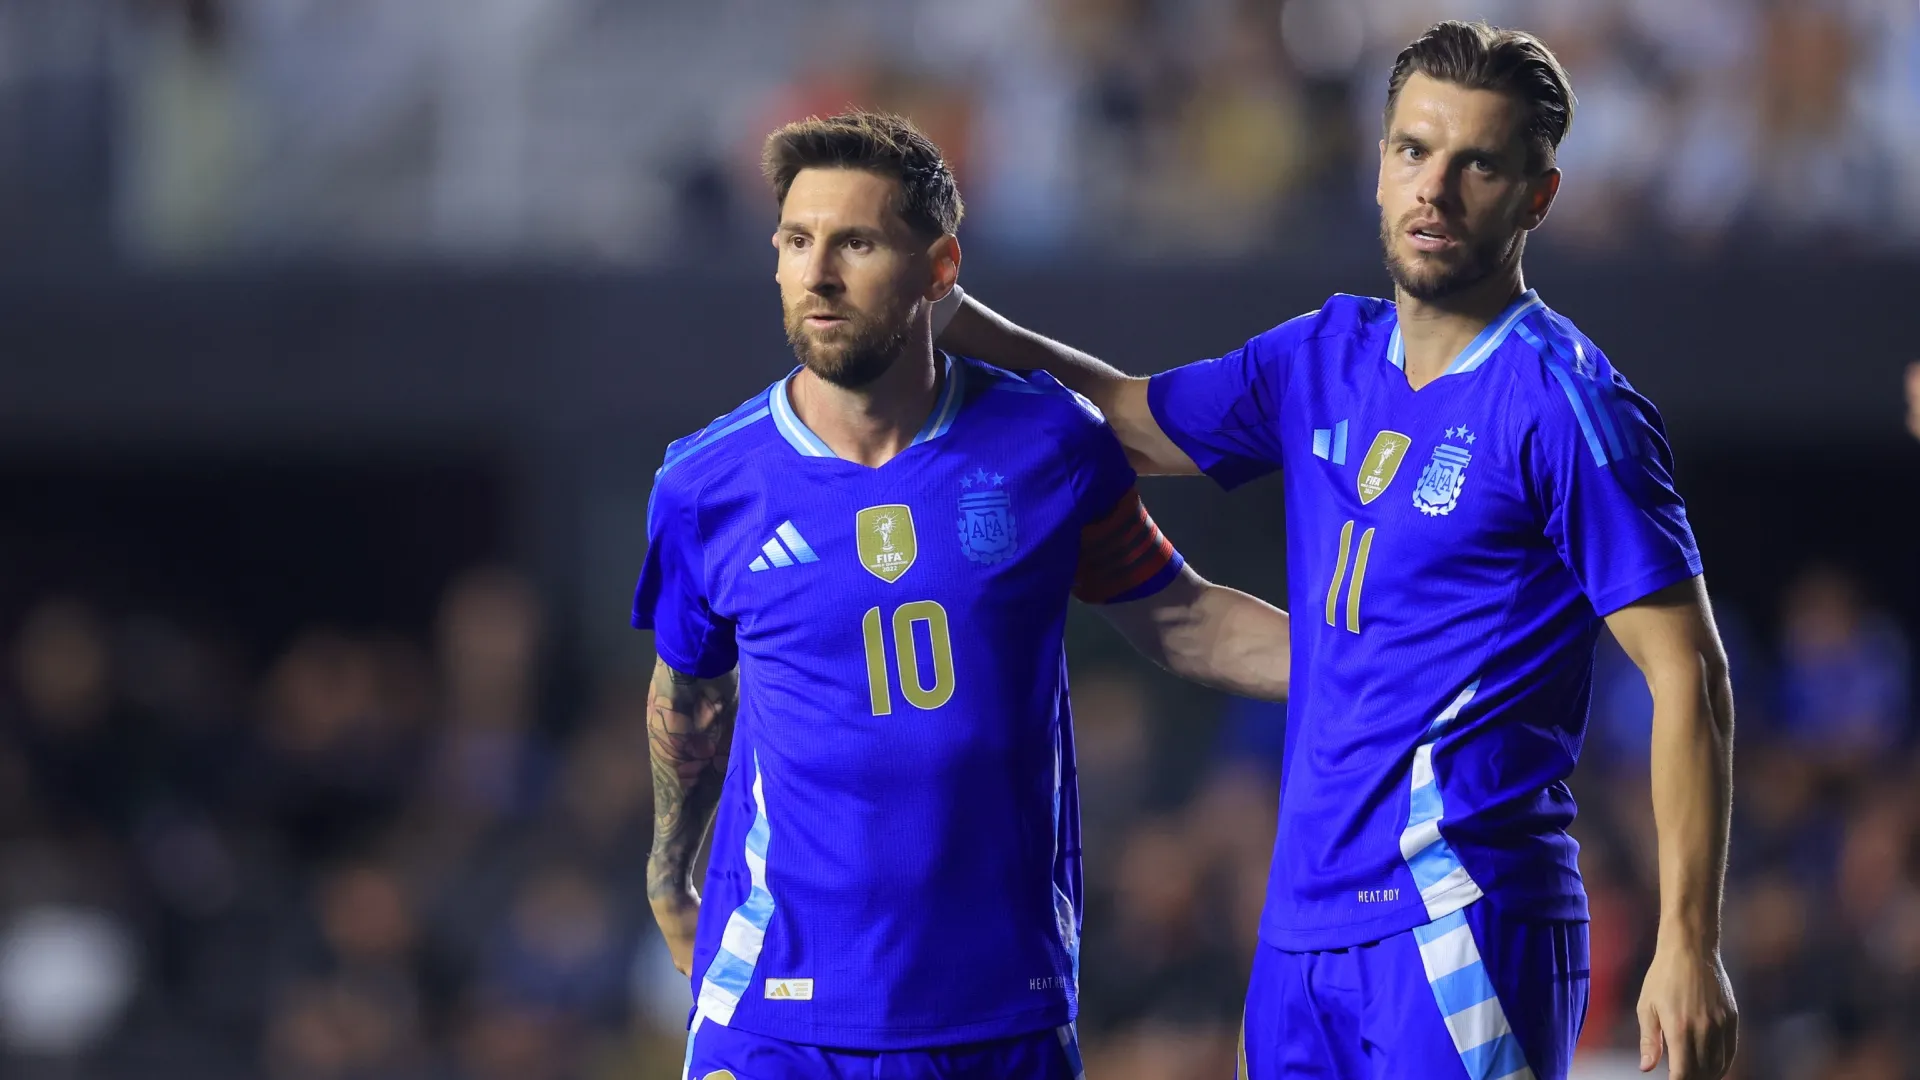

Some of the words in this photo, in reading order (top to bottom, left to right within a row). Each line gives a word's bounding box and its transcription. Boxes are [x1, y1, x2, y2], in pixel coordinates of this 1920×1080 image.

[1426, 463, 1454, 496] AFA
[971, 511, 1005, 543] AFA
[876, 553, 900, 564] FIFA
[1325, 520, 1376, 634] 11
[862, 600, 955, 716] 10
[1358, 888, 1400, 903] HEAT.RDY
